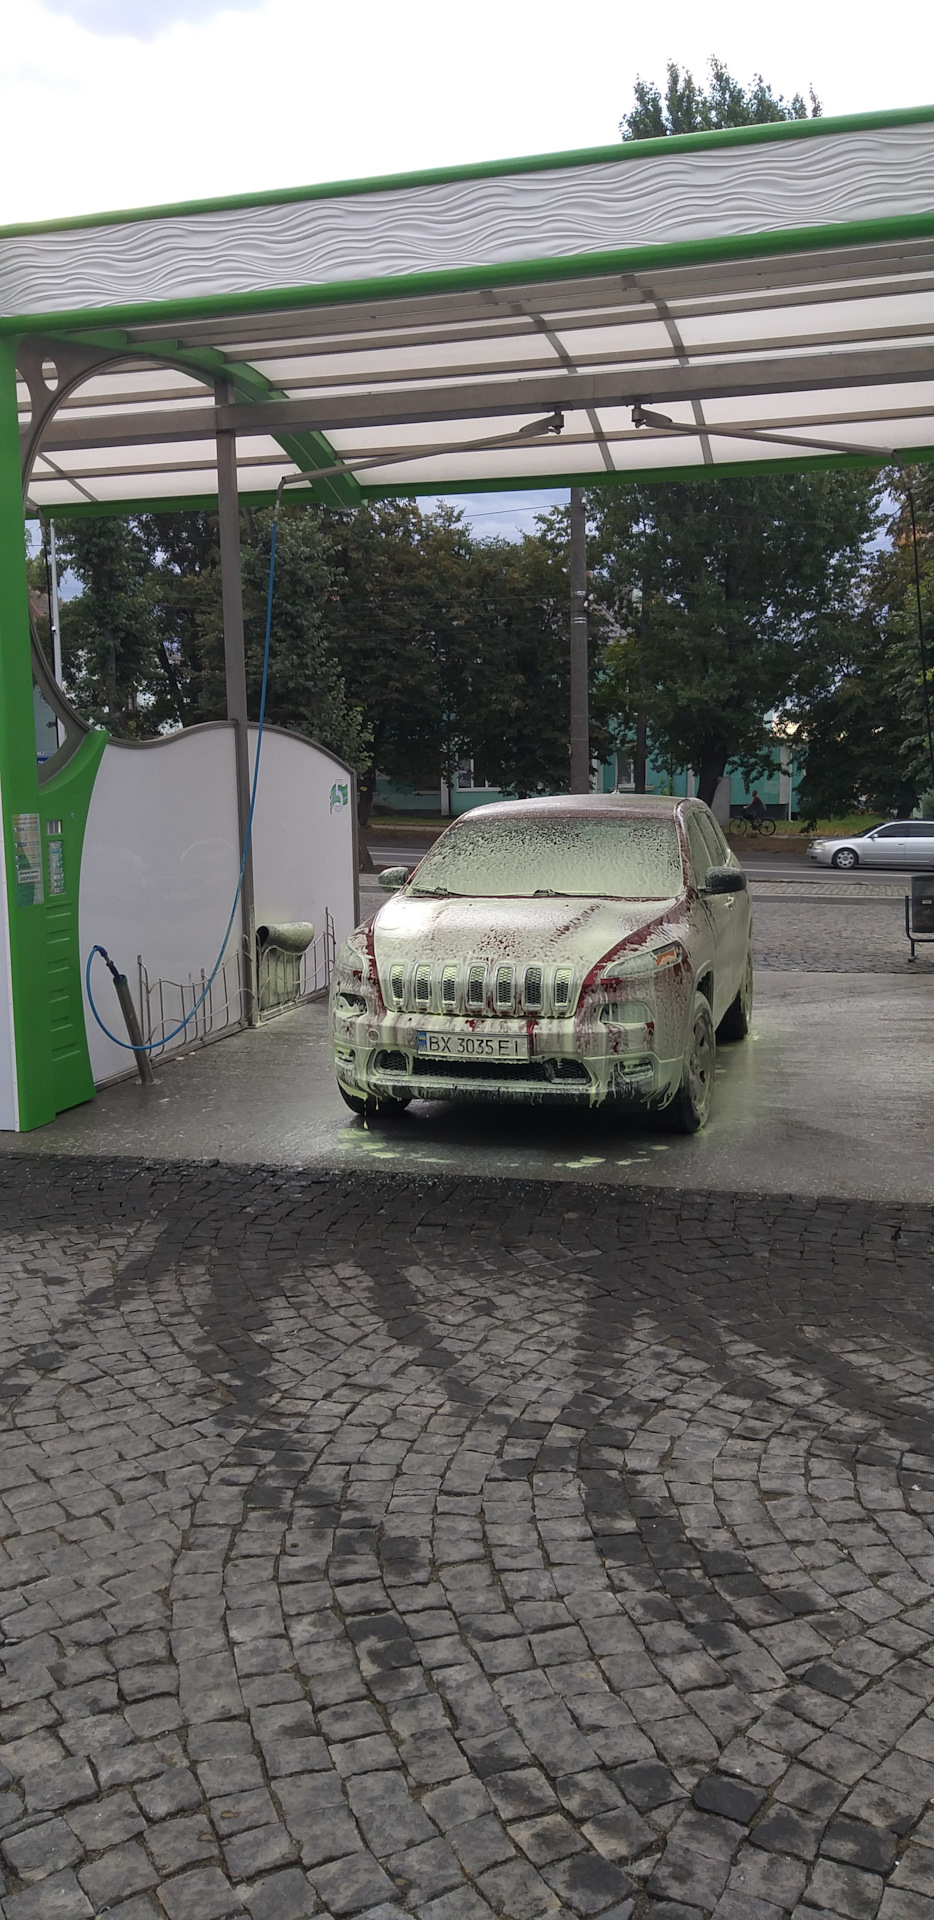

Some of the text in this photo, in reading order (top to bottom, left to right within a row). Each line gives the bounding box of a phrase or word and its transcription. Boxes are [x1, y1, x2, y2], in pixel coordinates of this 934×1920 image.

[429, 1035, 452, 1053] BX
[457, 1037, 494, 1055] 3035
[498, 1039, 518, 1056] EI
